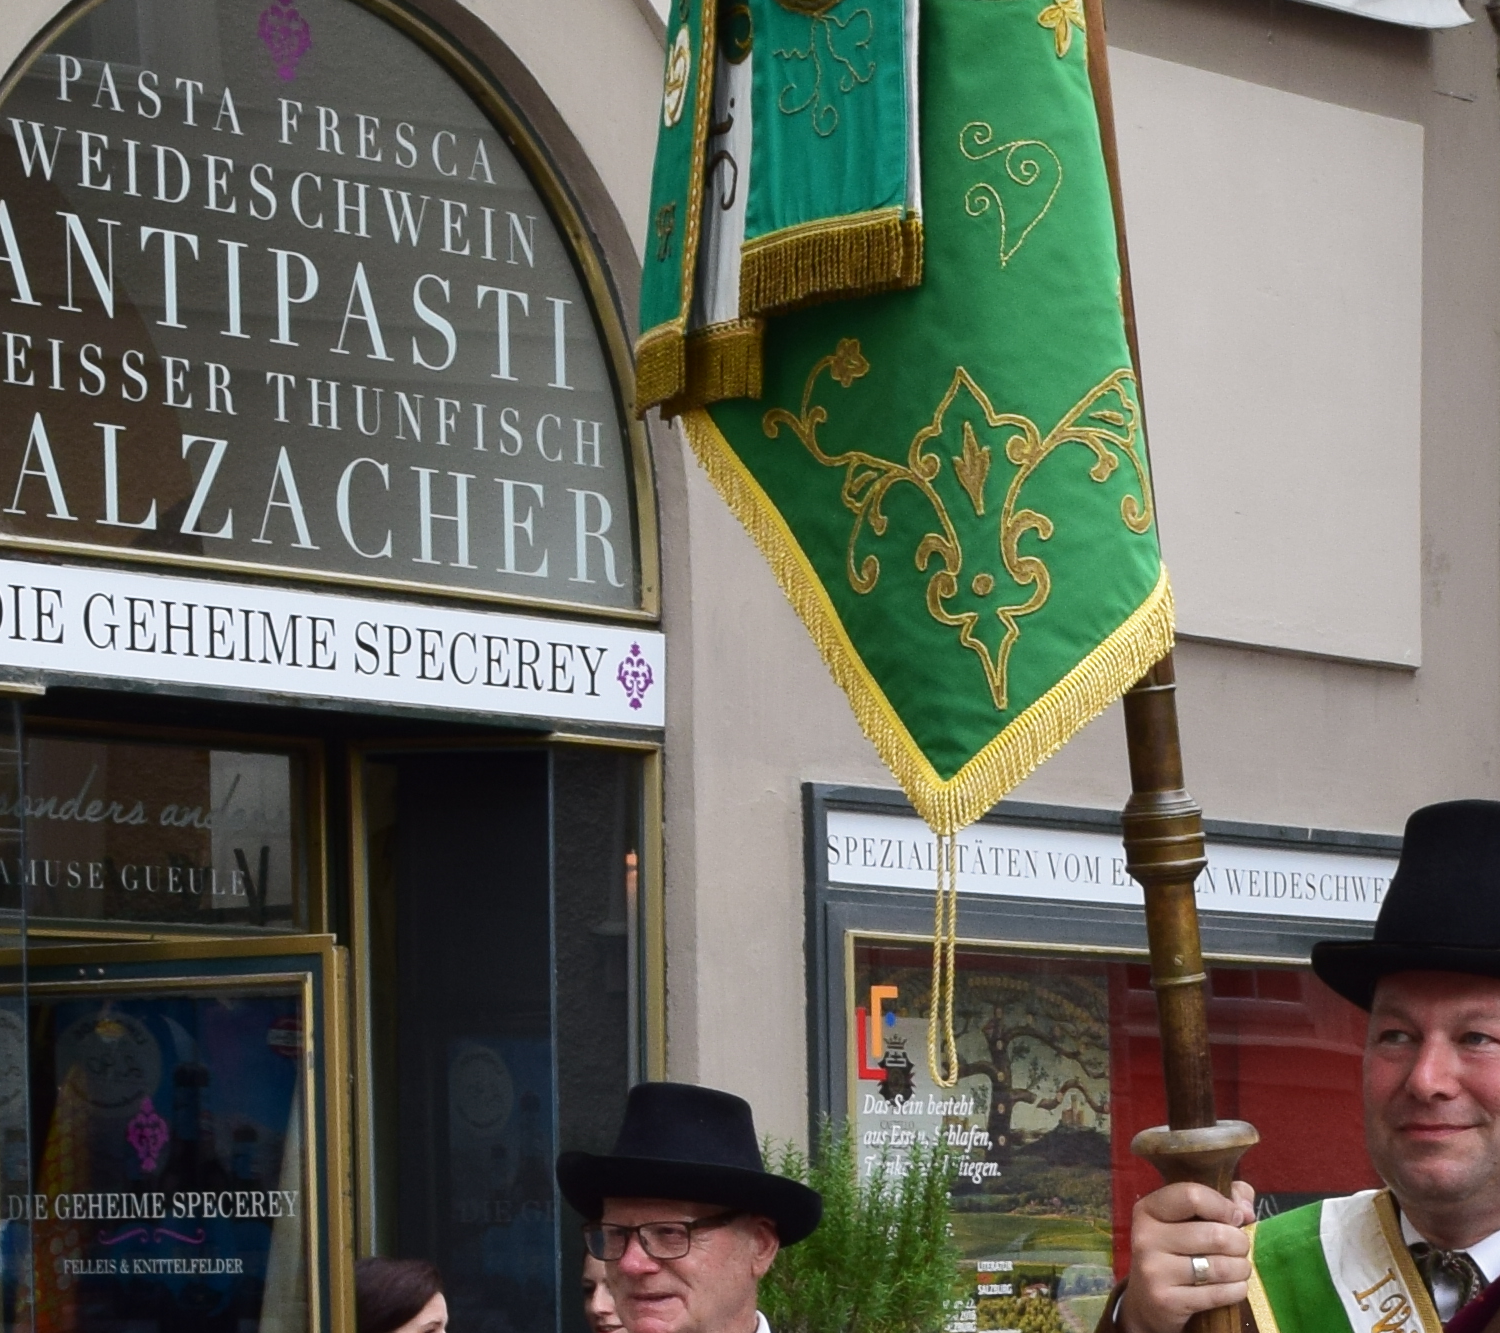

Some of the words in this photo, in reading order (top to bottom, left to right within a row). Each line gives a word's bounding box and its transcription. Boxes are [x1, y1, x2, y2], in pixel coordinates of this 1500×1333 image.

[56, 54, 244, 137] PASTA
[279, 98, 497, 186] FRESCA
[8, 117, 537, 269] WEIDESCHWEIN
[266, 372, 605, 470] THUNFISCH
[83, 592, 337, 672] GEHEIME
[354, 621, 609, 698] SPECEREY
[121, 864, 246, 897] GUEULE
[1047, 852, 1104, 884] VOM
[1225, 866, 1393, 905] WEIDESCHWE
[863, 1094, 890, 1115] Das
[893, 1093, 924, 1116] Sein
[927, 1094, 975, 1116] besteht
[8, 1193, 49, 1220] DIE
[54, 1192, 166, 1220] GEHEIME
[172, 1190, 299, 1218] SPECEREY
[63, 1259, 116, 1275] FELLEIS
[119, 1259, 130, 1275] &
[132, 1258, 244, 1275] KNITTELFELDER
